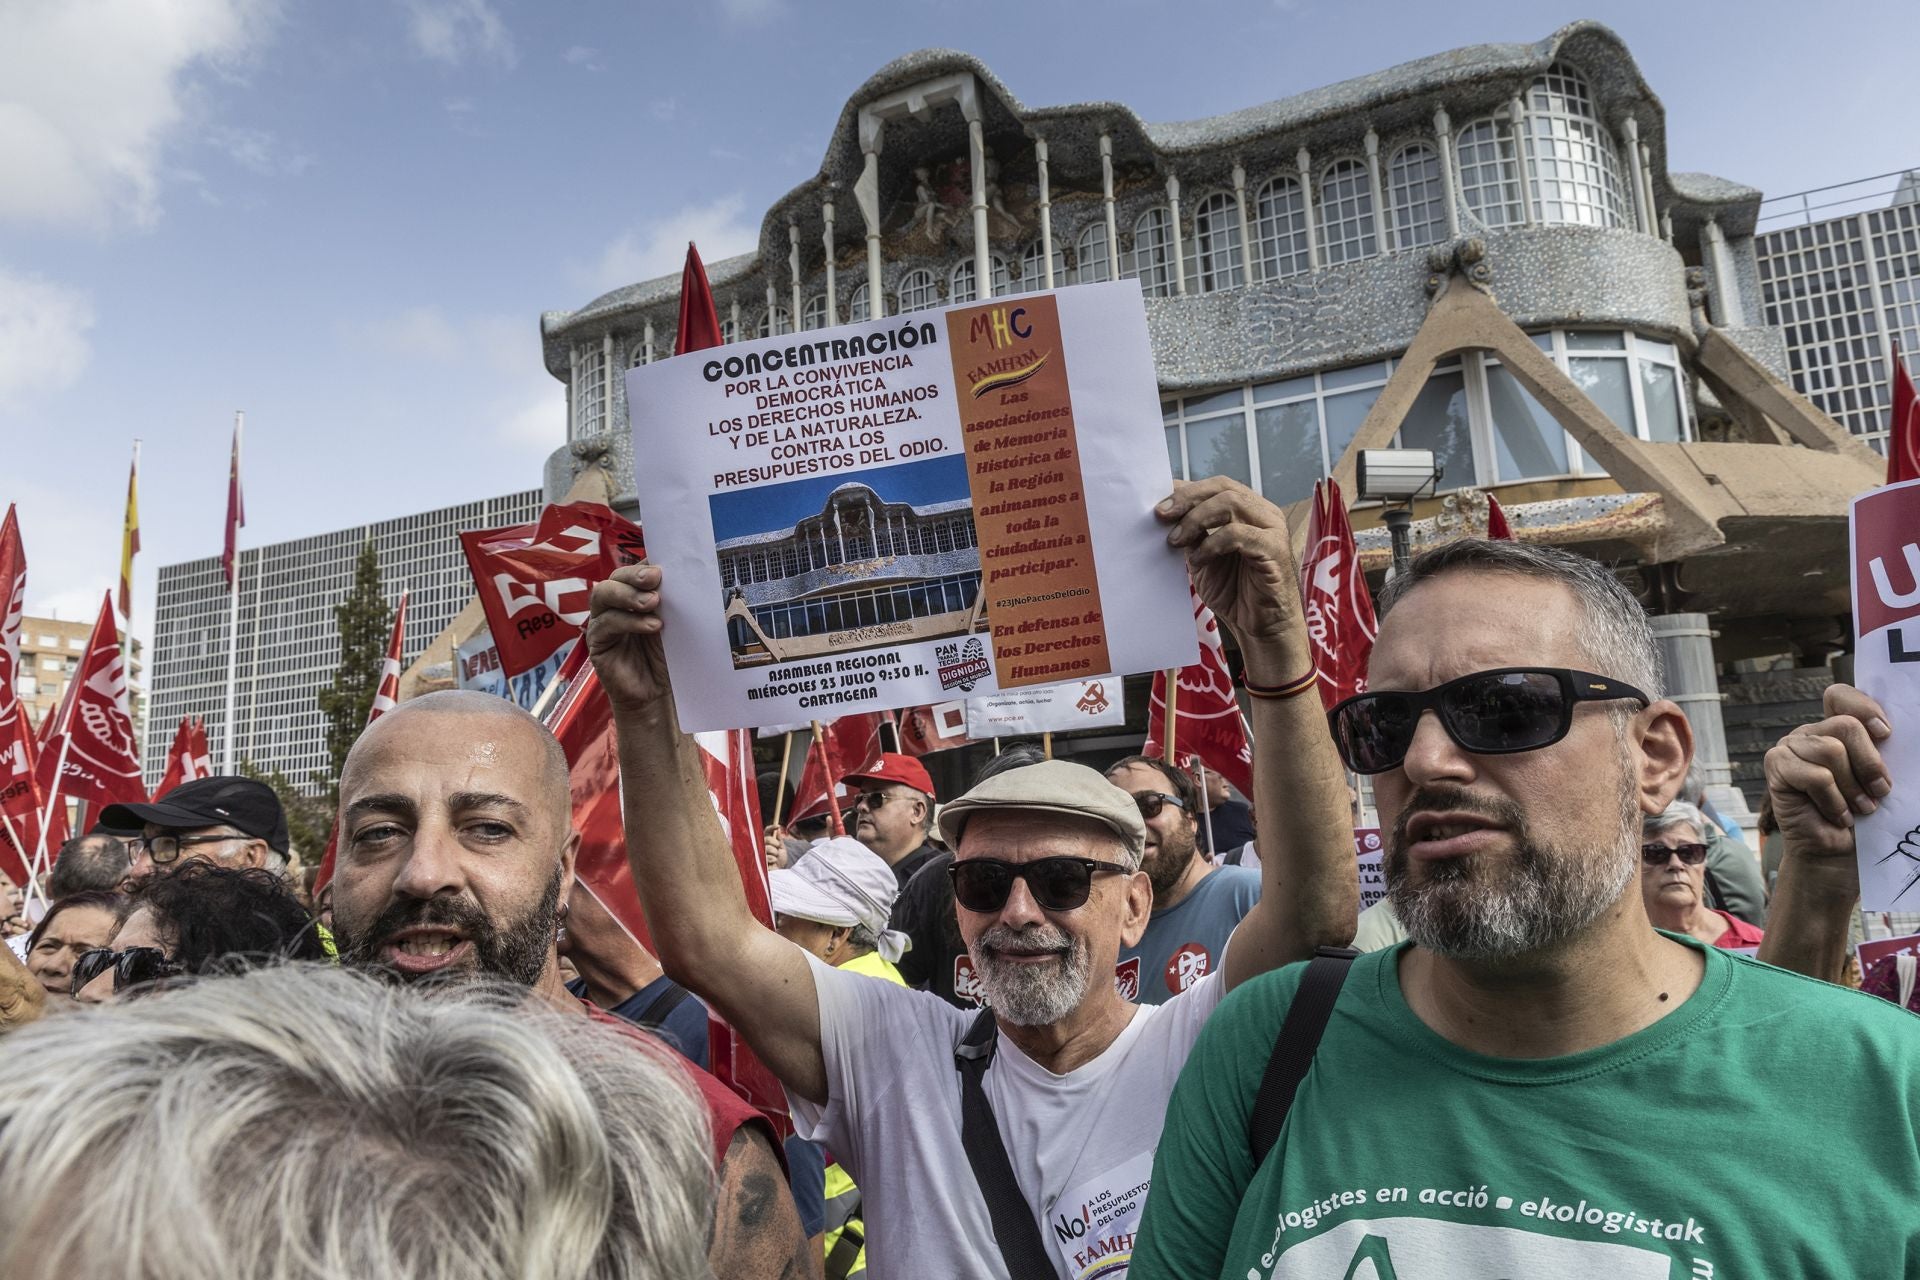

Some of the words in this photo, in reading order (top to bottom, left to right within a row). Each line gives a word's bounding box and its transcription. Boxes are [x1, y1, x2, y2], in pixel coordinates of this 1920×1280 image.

[970, 308, 1032, 350] MHC
[703, 320, 937, 382] CONCENTRACIÓN
[725, 379, 762, 397] POR
[766, 375, 789, 391] LA
[793, 354, 913, 385] CONVIVENCIA
[967, 349, 1040, 385] FAMHRM
[756, 377, 886, 410] DEMOCRÁTICA
[1000, 392, 1029, 406] Las
[709, 418, 743, 436] LOS
[748, 401, 845, 429] DERECHOS
[850, 384, 938, 412] HUMANOS
[966, 406, 1070, 433] asociaciones
[729, 435, 740, 450] Y
[746, 431, 769, 447] DE
[774, 429, 797, 443] LA
[801, 407, 922, 438] NATURALEZA.
[974, 440, 991, 453] de
[994, 427, 1067, 450] Memoria
[771, 437, 844, 460] CONTRA
[849, 430, 885, 448] LOS
[714, 453, 854, 488] PRESUPUESTOS
[860, 447, 895, 465] DEL
[900, 438, 948, 458] ODIO.
[976, 453, 1051, 474] Histórica
[1054, 448, 1072, 460] de
[989, 480, 1005, 493] la
[1008, 471, 1065, 490] Región
[980, 493, 1067, 516] animamos
[1069, 492, 1080, 502] a
[1006, 519, 1041, 534] toda
[1044, 515, 1060, 528] la
[985, 534, 1073, 559] ciudadanía
[1076, 534, 1086, 544] a
[989, 556, 1079, 583] participar.
[993, 625, 1015, 638] En
[1017, 616, 1080, 634] defensa
[1083, 611, 1102, 624] de
[935, 643, 958, 657] PAN
[997, 646, 1021, 659] los
[1025, 634, 1101, 655] Derechos
[768, 663, 833, 682] ASAMBLEA
[836, 652, 902, 673] REGIONAL
[941, 660, 988, 682] DIGNIDAD
[1010, 658, 1090, 679] Humanos
[747, 678, 817, 700] MIÉRCOLES
[820, 676, 837, 690] 23
[840, 669, 876, 688] JULIO
[878, 666, 911, 682] 9:30
[914, 664, 930, 678] H.
[799, 686, 879, 709] CARTAGENA
[1088, 1200, 1095, 1208] A
[1095, 1189, 1112, 1203] LOS
[1097, 1214, 1114, 1227] DEL
[1114, 1201, 1136, 1218] ODIO
[1376, 1187, 1408, 1203] en
[1418, 1185, 1489, 1208] acció
[1519, 1197, 1705, 1244] ekologistak
[1073, 1232, 1137, 1270] FAMH
